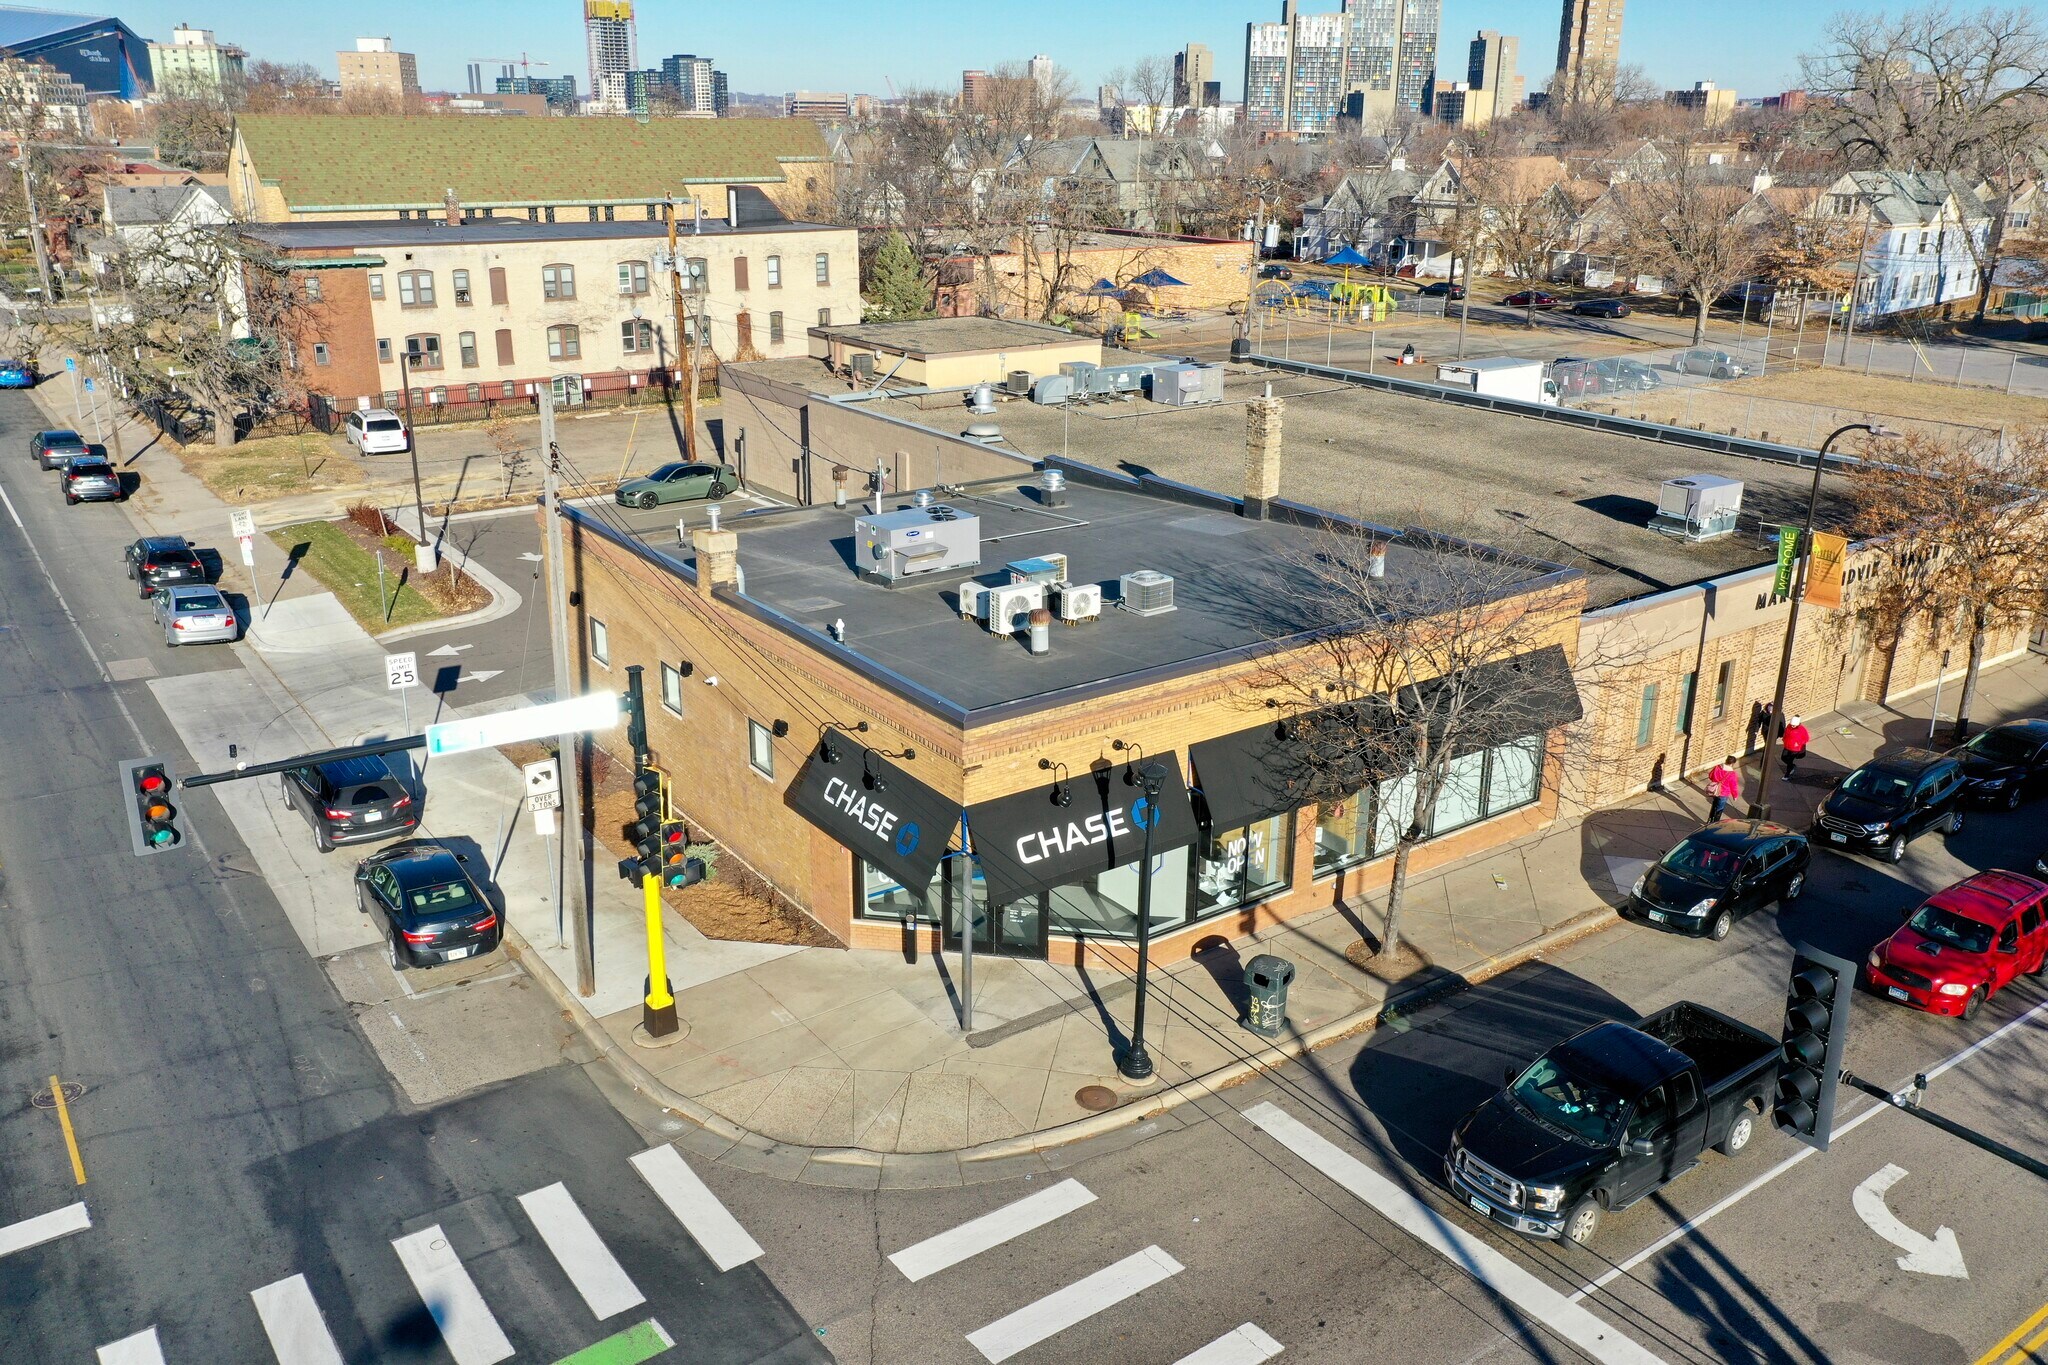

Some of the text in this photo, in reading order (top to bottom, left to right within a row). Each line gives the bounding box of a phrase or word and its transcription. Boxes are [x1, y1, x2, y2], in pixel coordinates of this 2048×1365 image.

[1778, 531, 1795, 590] WELCOME
[389, 657, 413, 665] SPEED
[391, 670, 414, 685] 25
[534, 794, 553, 803] OVER
[539, 799, 557, 809] TONS
[823, 777, 899, 842] CHASE
[1016, 807, 1131, 865] CHASE
[1227, 847, 1265, 874] OPN
